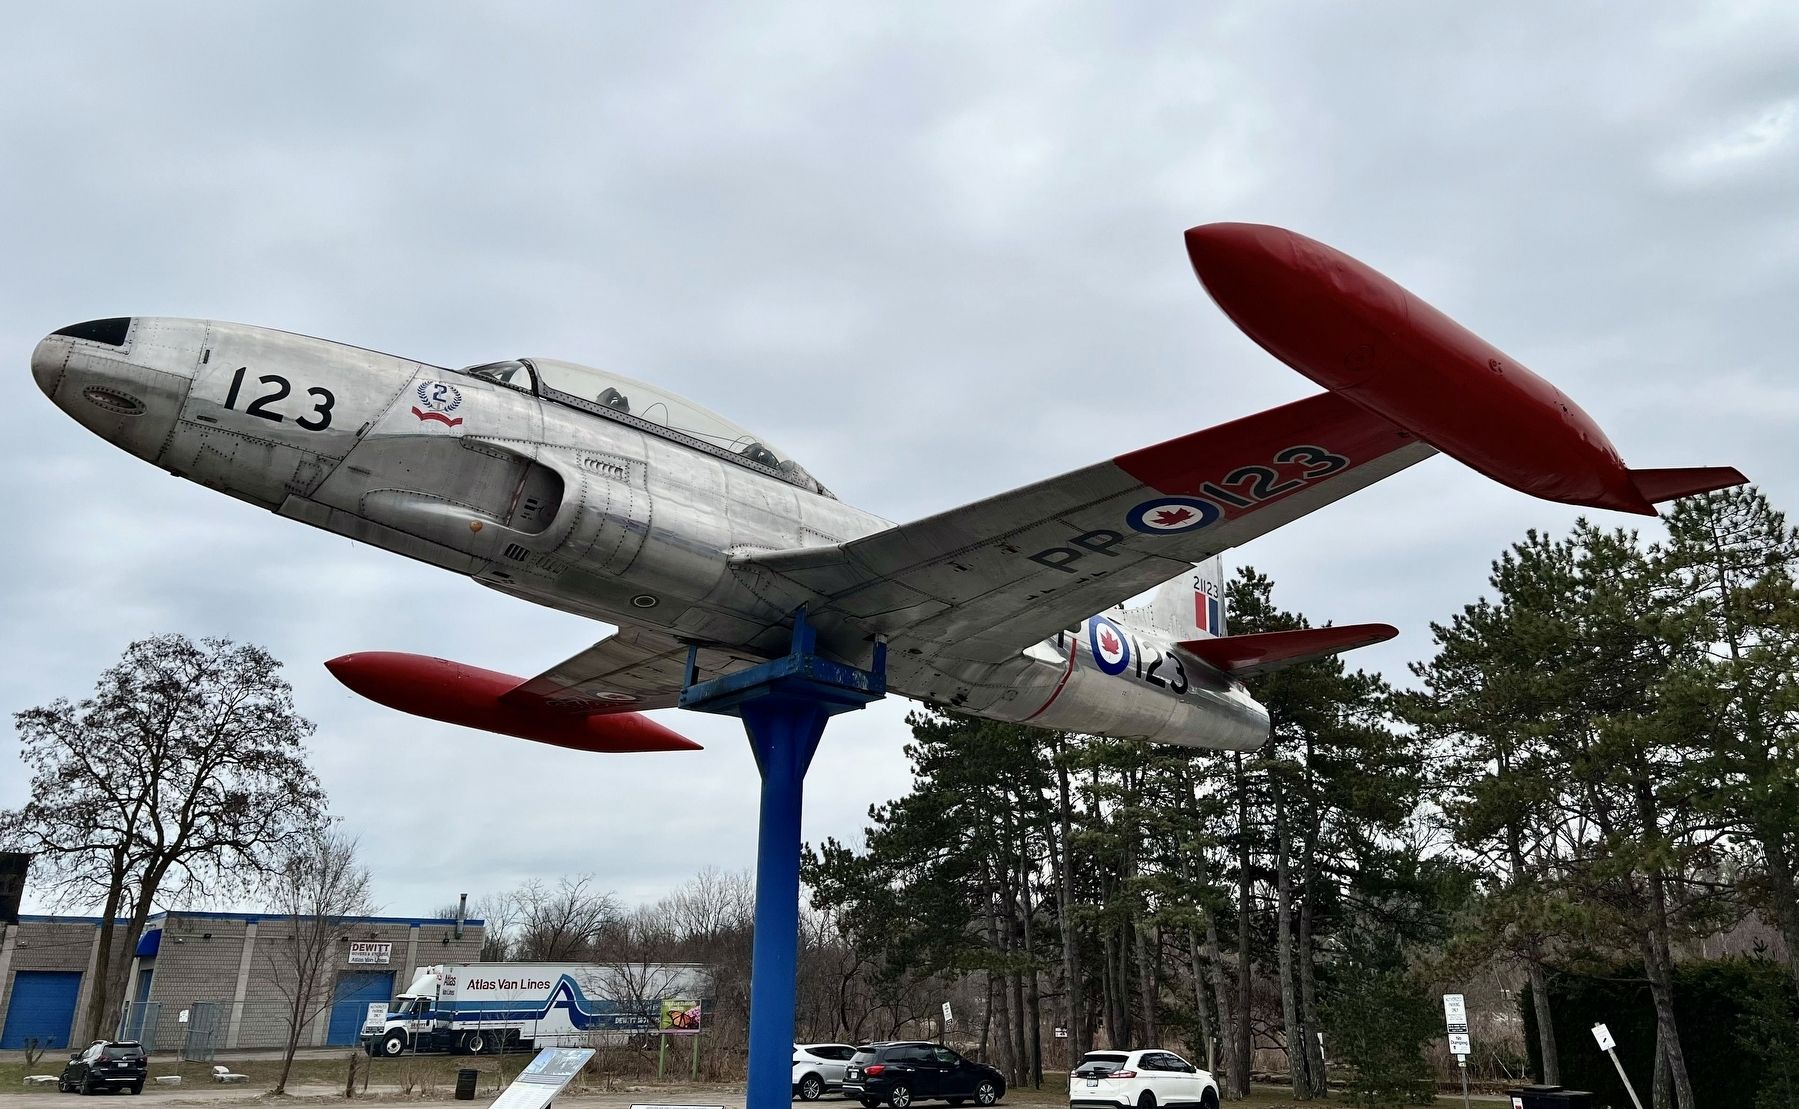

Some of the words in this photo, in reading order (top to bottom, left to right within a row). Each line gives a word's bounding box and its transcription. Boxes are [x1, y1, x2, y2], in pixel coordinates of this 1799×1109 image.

[223, 366, 335, 431] 123
[433, 384, 447, 403] 2
[1202, 445, 1349, 508] 123
[1029, 529, 1125, 574] PP
[1193, 576, 1219, 599] 21123
[1132, 634, 1189, 695] 123
[352, 943, 390, 952] DEWITT
[467, 979, 496, 990] Atlas
[498, 979, 518, 990] Van
[520, 979, 551, 990] Lines
